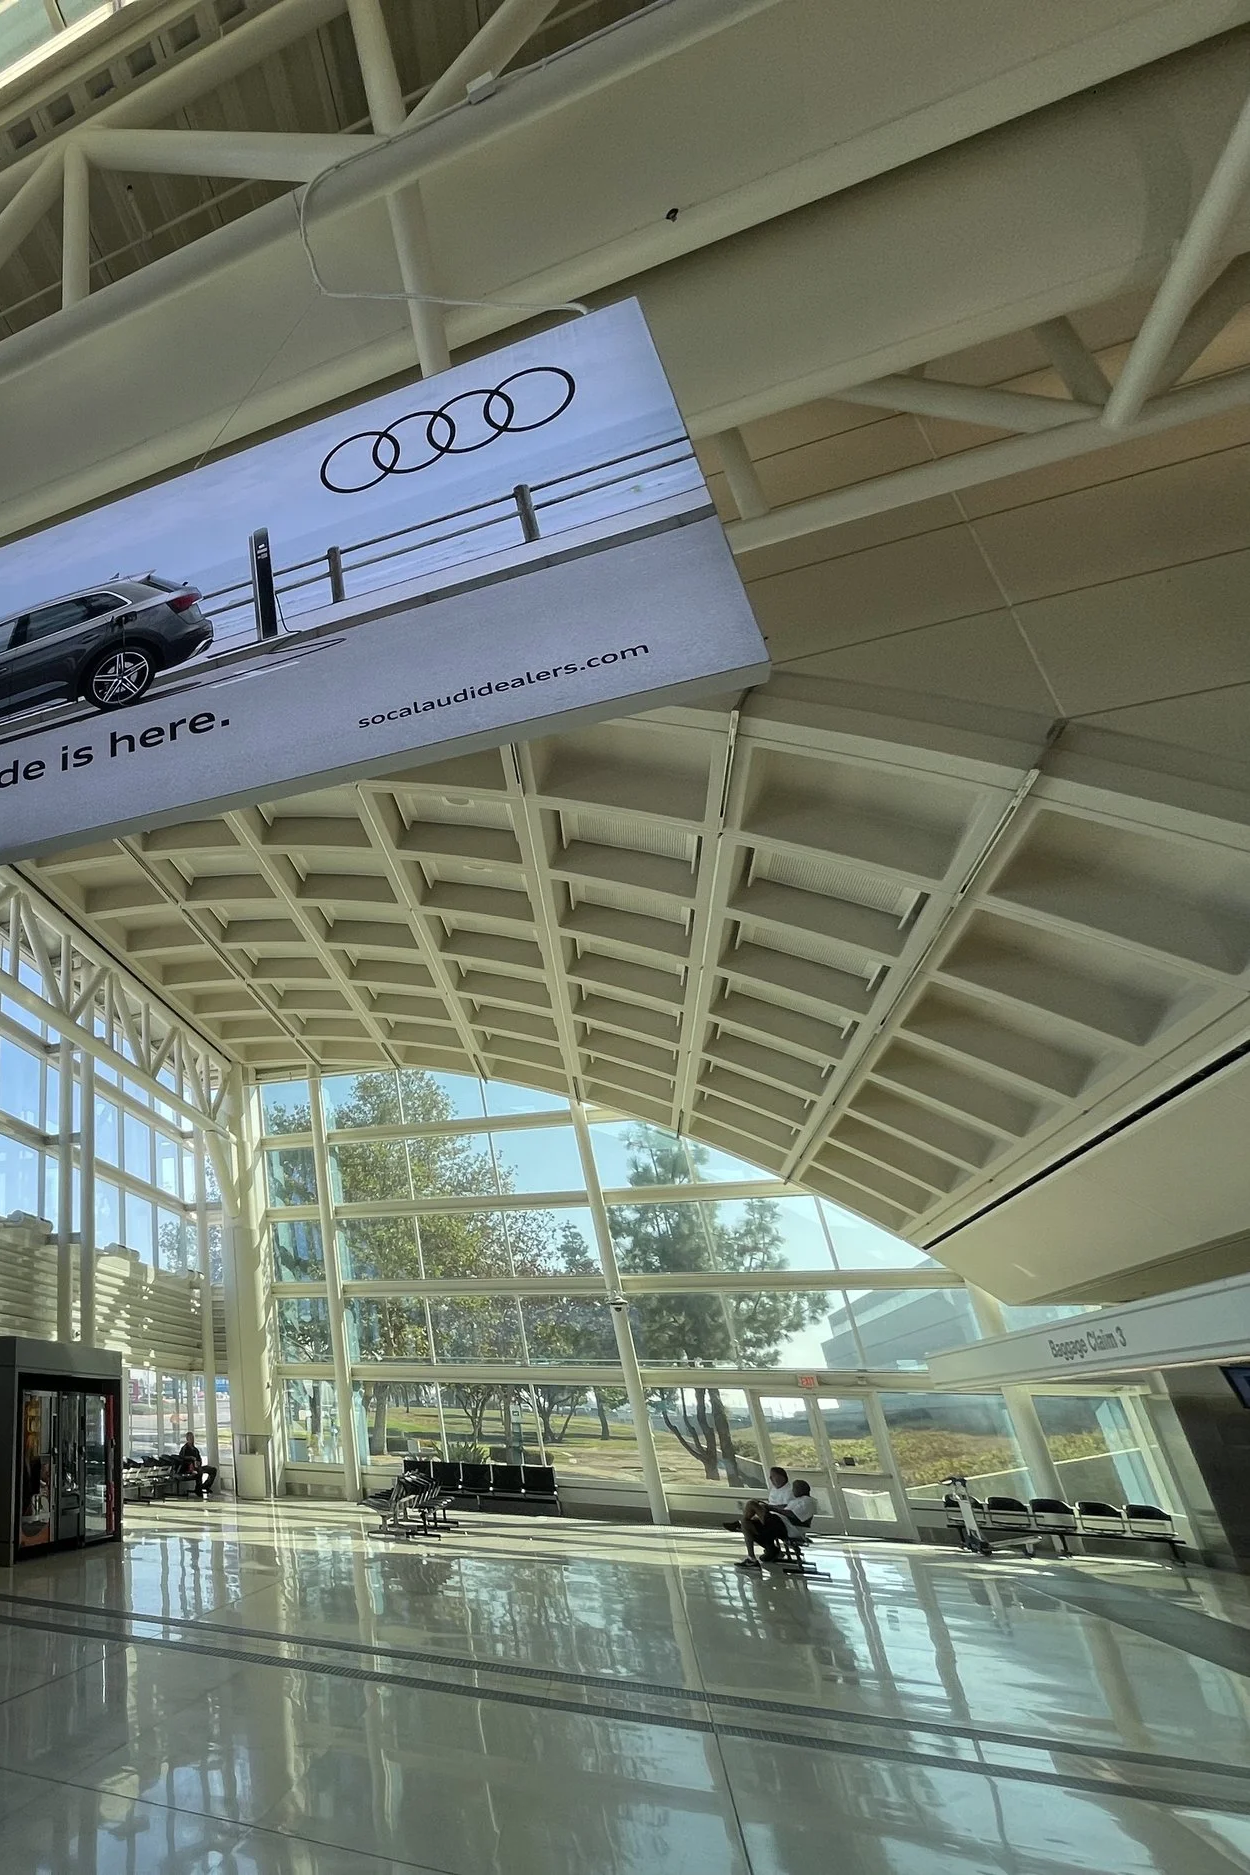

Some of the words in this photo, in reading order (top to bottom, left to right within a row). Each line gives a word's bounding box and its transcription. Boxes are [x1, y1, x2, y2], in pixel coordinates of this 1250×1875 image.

[358, 644, 650, 729] socalaudidealers.com
[61, 744, 94, 772] is
[109, 711, 230, 759] here.
[1048, 1339, 1088, 1361] Baggage
[1086, 1329, 1119, 1352] Claim
[1116, 1326, 1127, 1348] 3
